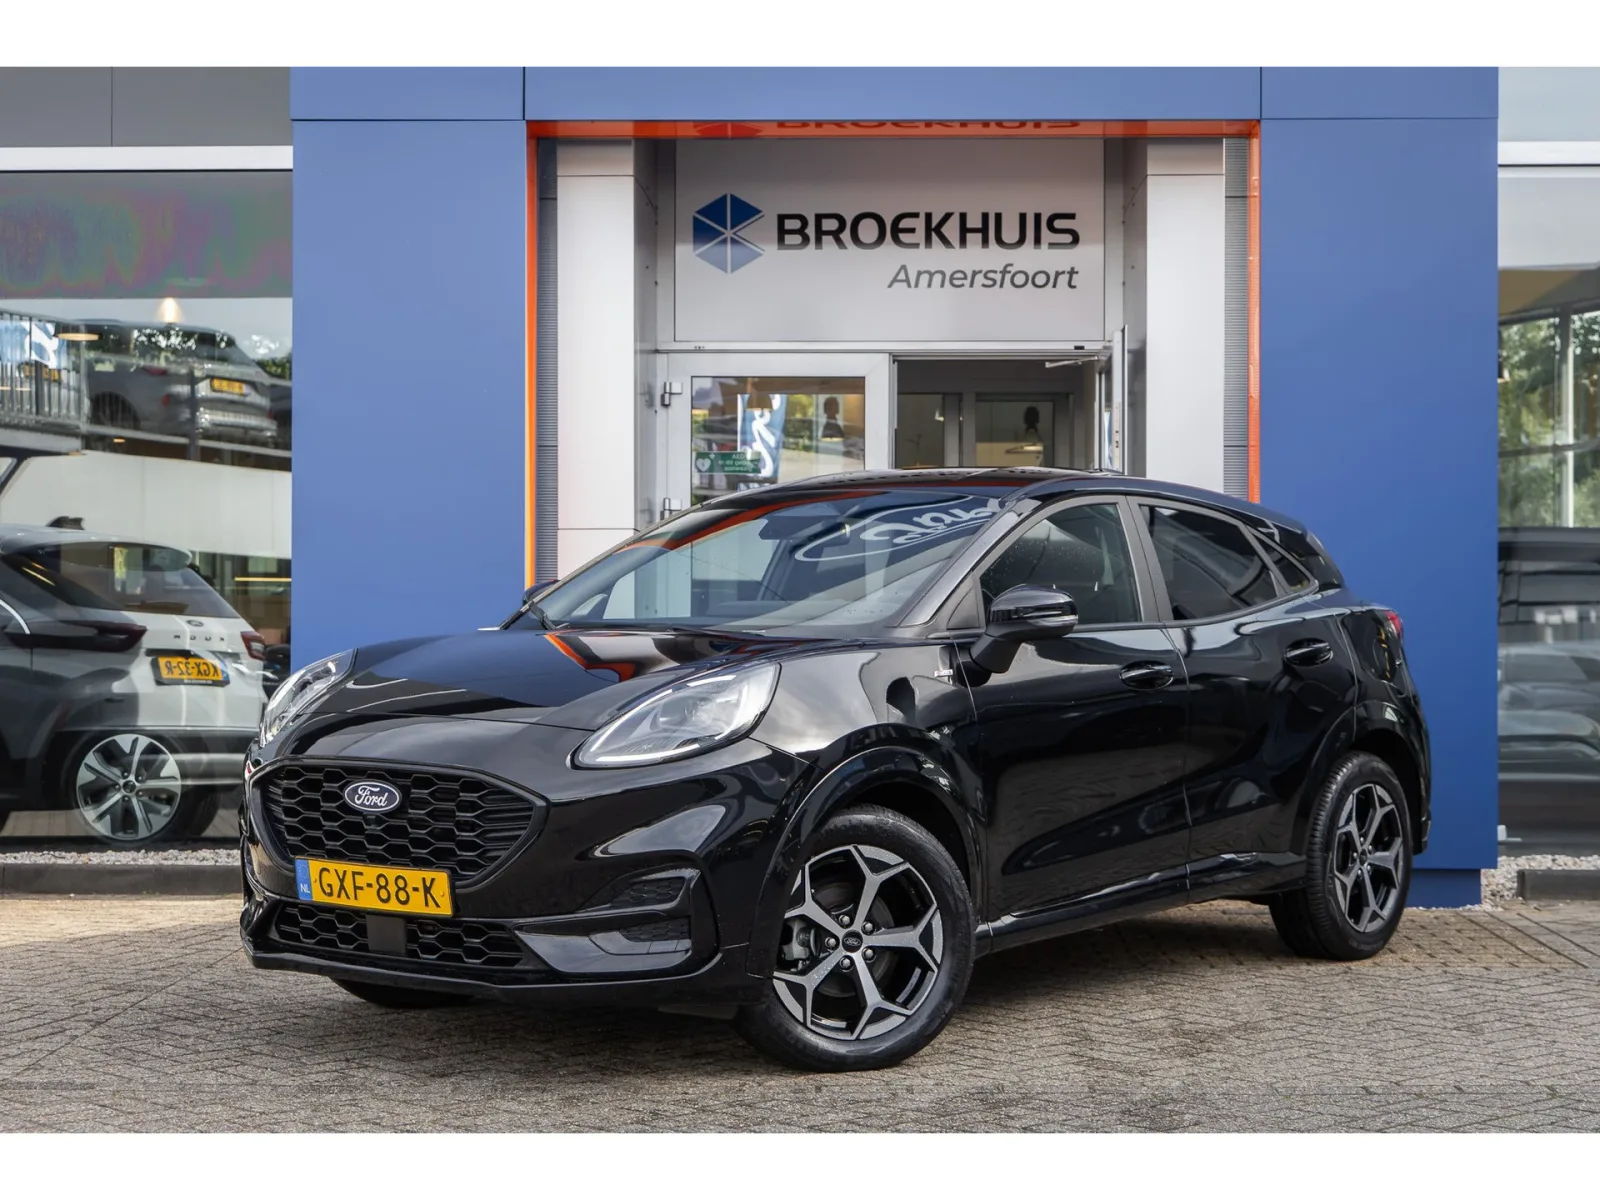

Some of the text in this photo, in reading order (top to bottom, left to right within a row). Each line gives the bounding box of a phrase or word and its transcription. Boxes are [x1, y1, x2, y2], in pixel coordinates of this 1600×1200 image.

[776, 211, 1081, 251] BROEKHUIS
[887, 263, 1079, 290] Amersfoort
[355, 785, 389, 807] Ford
[300, 883, 311, 894] NL
[318, 867, 442, 909] GXF-88-K
